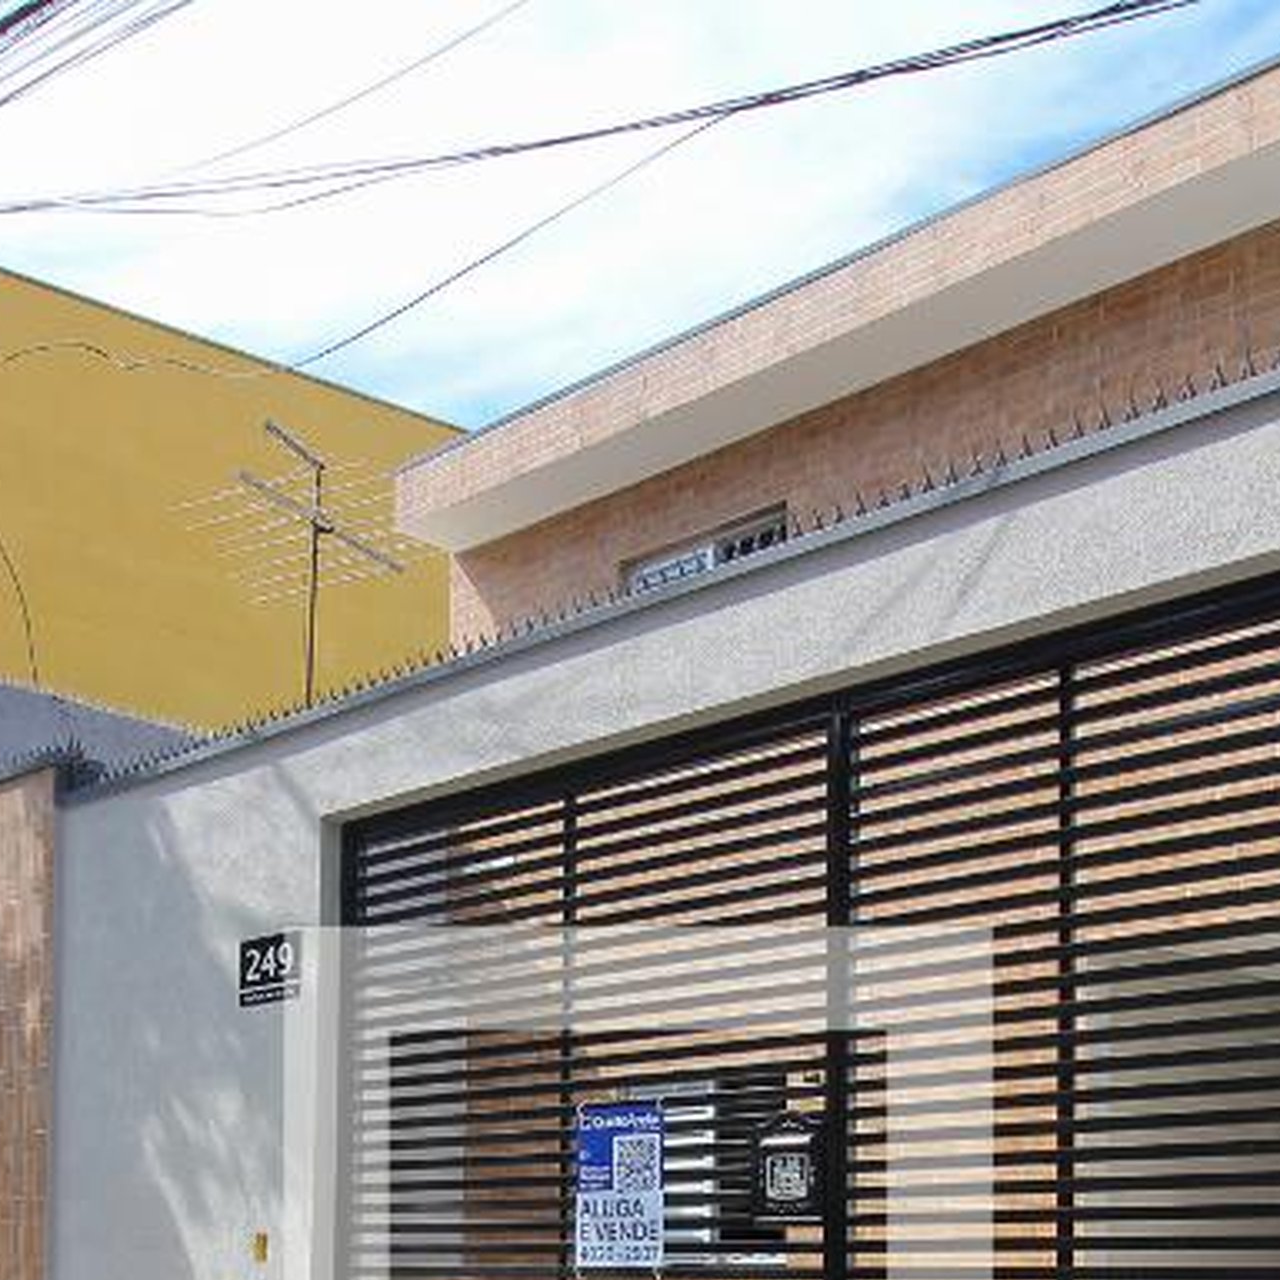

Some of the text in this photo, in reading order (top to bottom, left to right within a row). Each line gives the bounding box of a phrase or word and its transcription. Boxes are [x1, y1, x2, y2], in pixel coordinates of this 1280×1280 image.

[245, 942, 294, 981] 249
[580, 1198, 645, 1218] ALUGA
[581, 1219, 659, 1241] E VENDE
